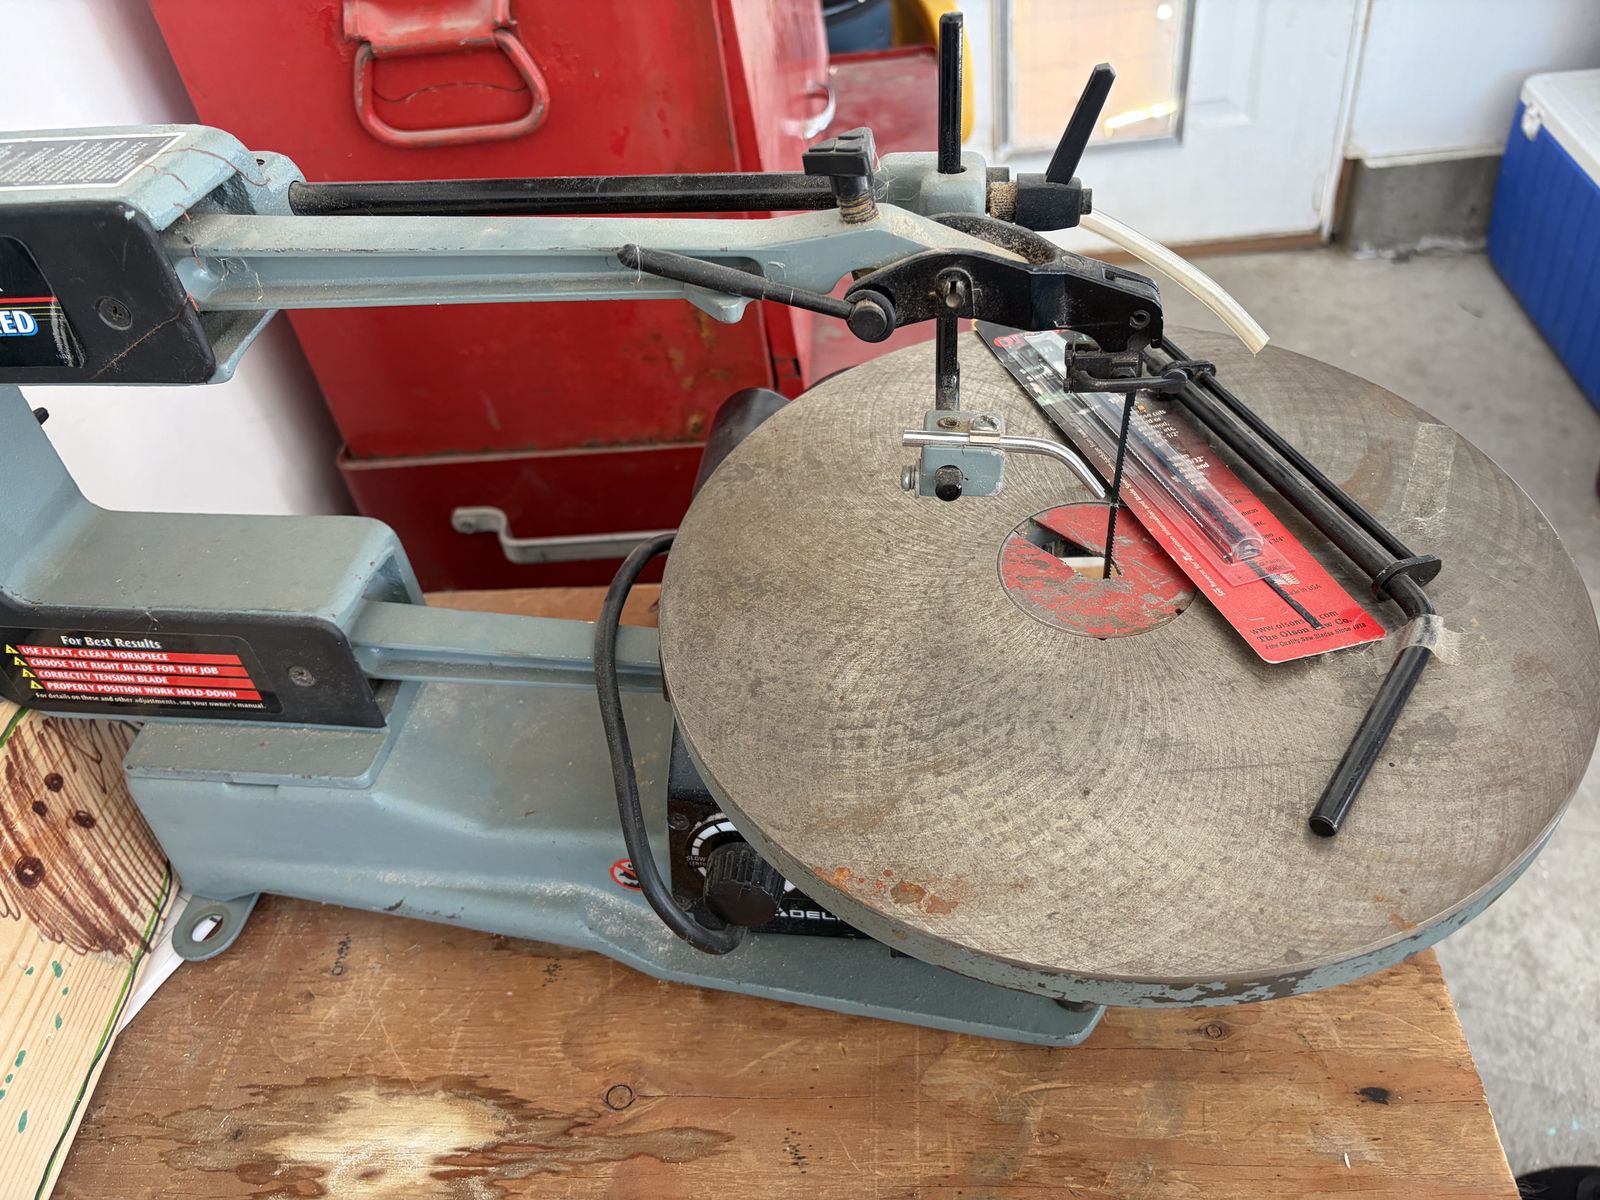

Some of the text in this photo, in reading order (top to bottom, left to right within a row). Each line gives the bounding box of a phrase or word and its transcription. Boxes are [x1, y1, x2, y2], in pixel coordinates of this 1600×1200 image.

[0, 310, 36, 334] ED
[60, 635, 162, 650] For Best Results
[1257, 634, 1278, 642] The
[1280, 628, 1310, 637] Olson
[22, 646, 40, 655] USE
[78, 650, 109, 658] CLEAN
[110, 652, 169, 661] WORKPIECE
[30, 658, 219, 676] CHOOSE THE RIGHT BLADE FOR THE JOB
[38, 670, 168, 684] CORRECTLY TENSION BLADE
[46, 682, 237, 698] PROPERLY POSITION WORK HOLD-DOWN
[790, 910, 840, 920] DEL
